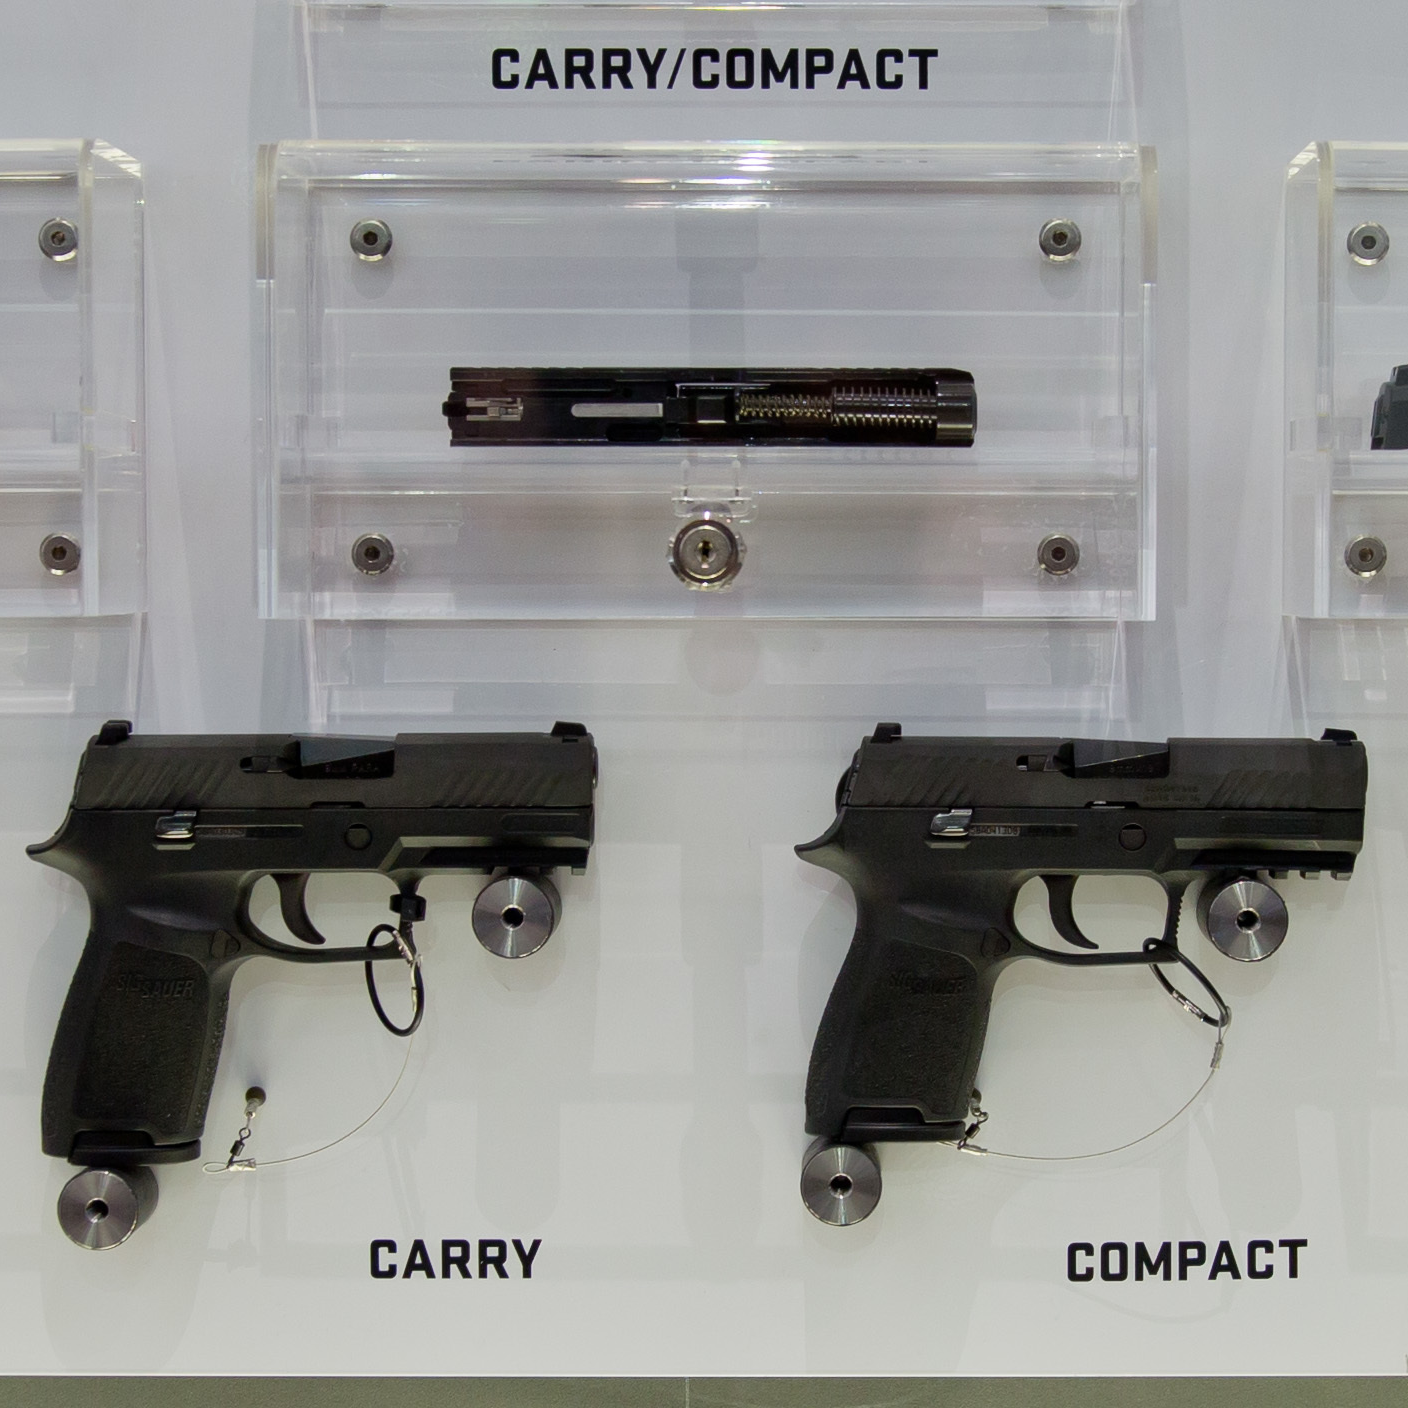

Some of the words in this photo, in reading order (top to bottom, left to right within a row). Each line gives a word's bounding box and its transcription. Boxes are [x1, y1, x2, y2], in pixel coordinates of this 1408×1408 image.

[491, 47, 940, 91] CARRY/COMPACT
[370, 1239, 542, 1280] CARRY
[1066, 1238, 1309, 1282] COMPACT
